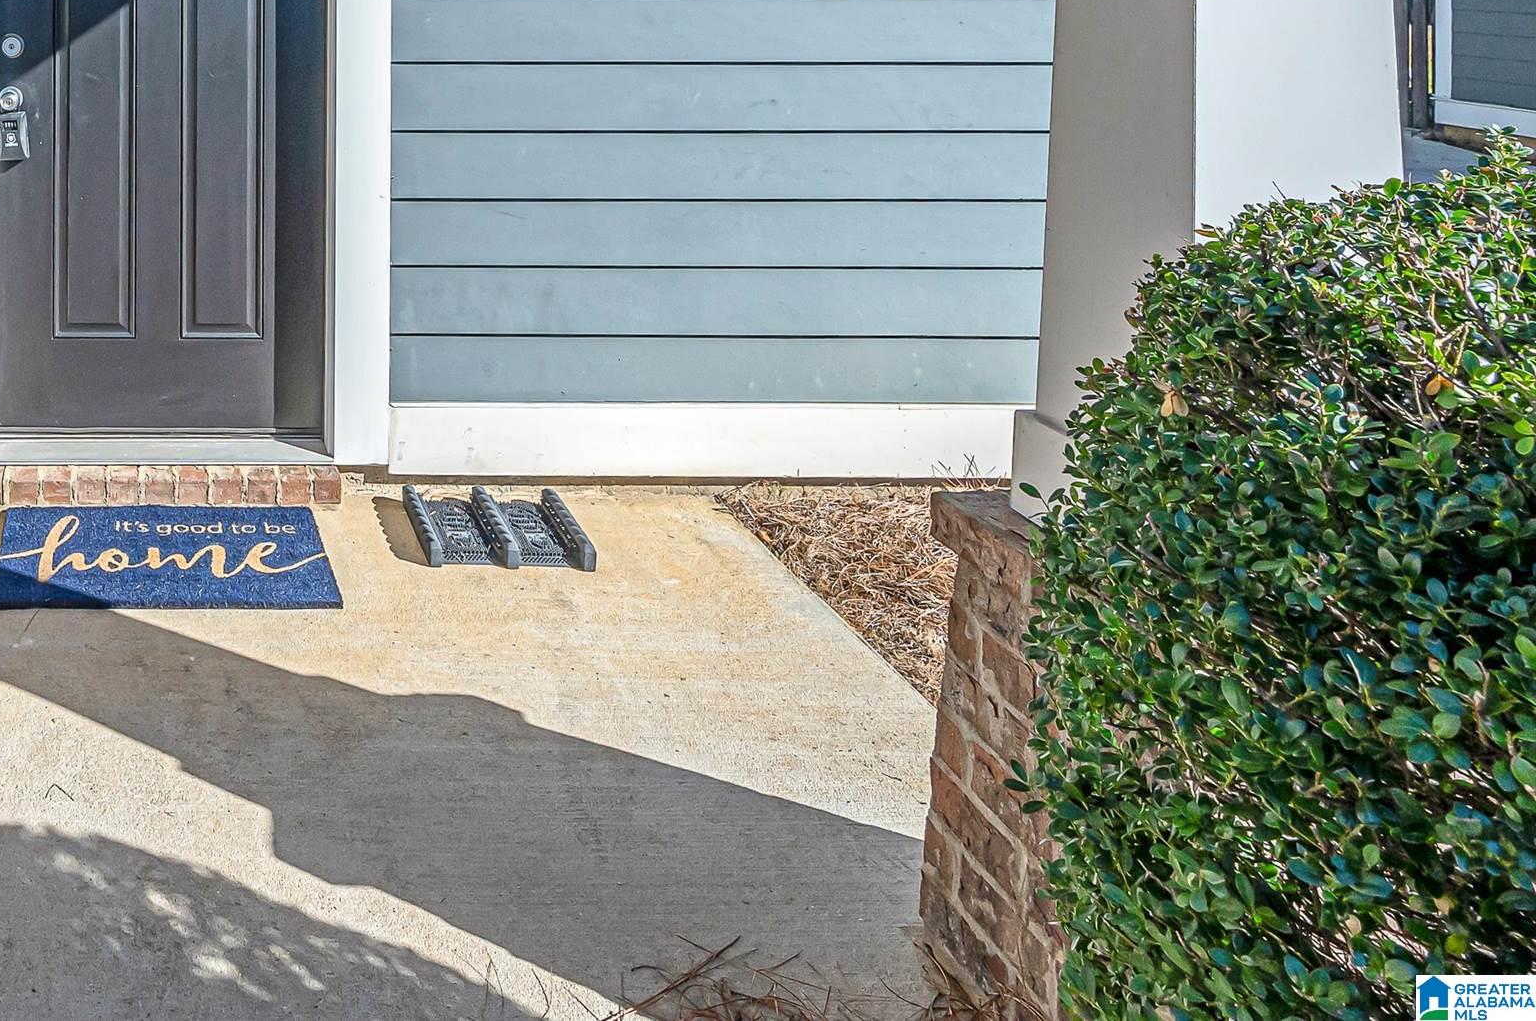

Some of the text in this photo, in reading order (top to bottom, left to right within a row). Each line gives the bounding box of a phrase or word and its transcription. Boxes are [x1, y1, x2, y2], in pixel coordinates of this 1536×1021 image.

[115, 520, 296, 536] It's good to be
